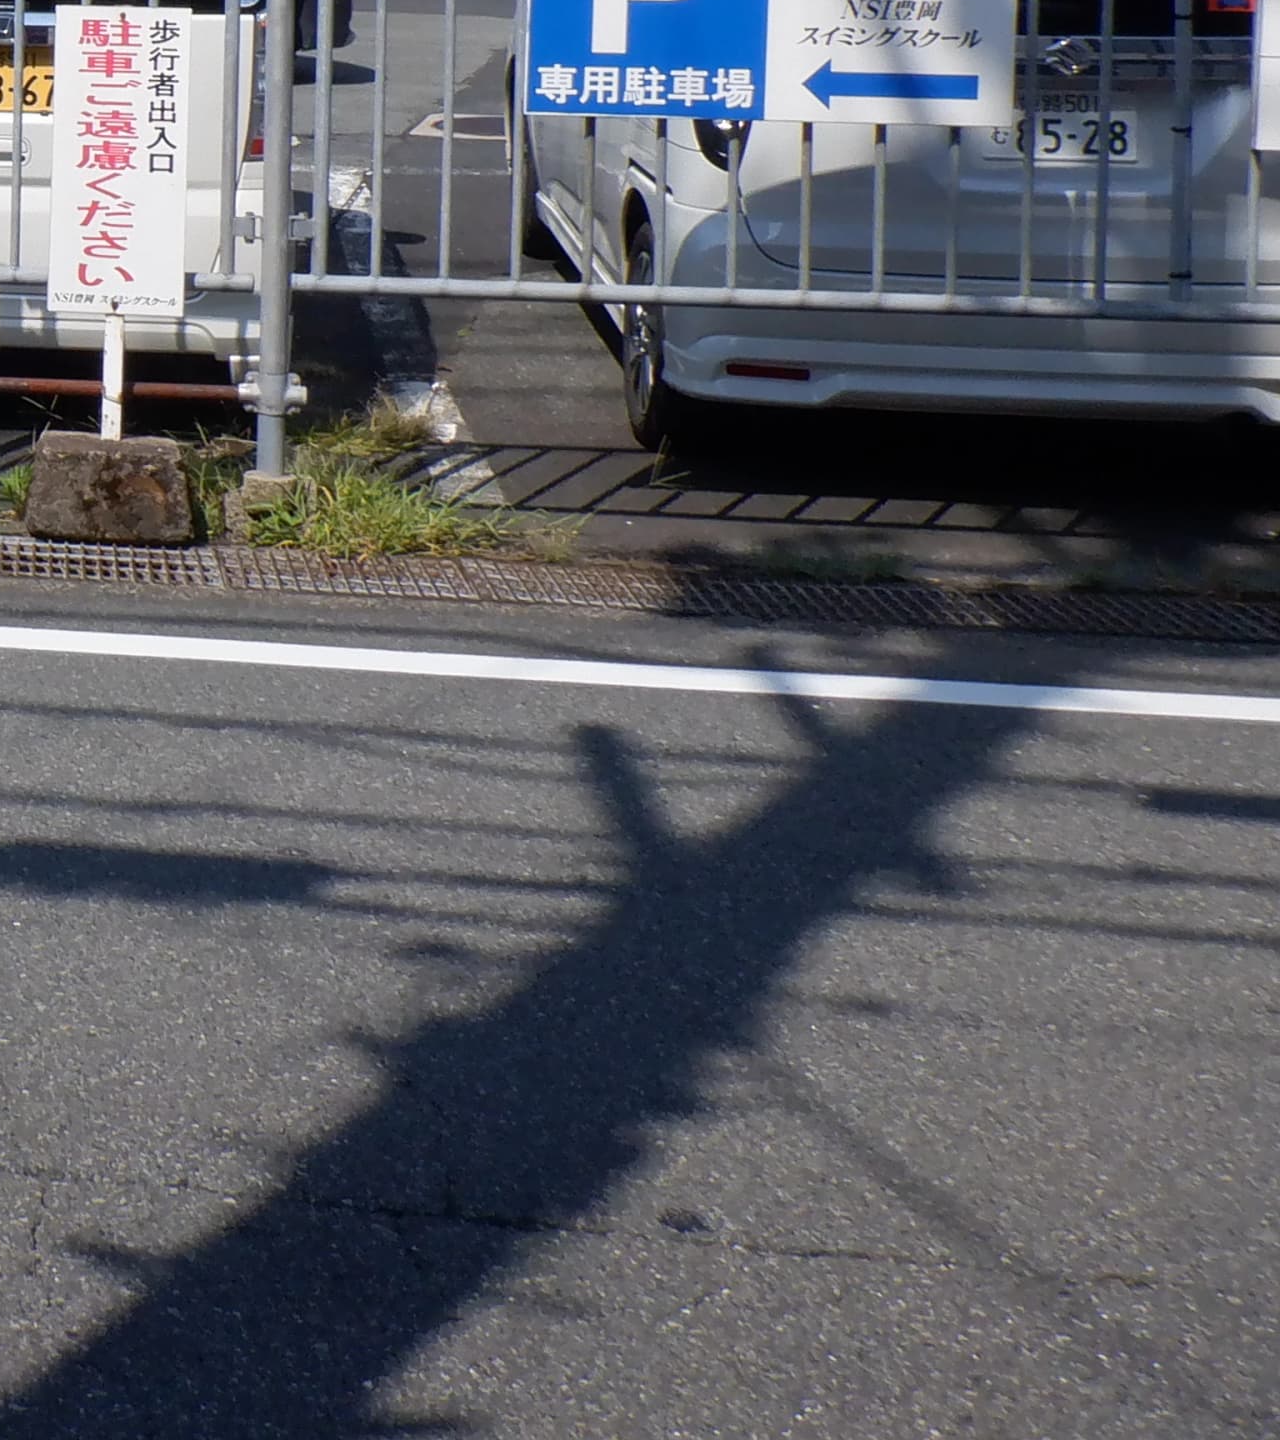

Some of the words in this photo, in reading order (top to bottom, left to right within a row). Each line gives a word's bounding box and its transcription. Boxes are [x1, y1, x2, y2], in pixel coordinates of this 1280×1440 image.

[840, 0, 942, 21] NSI豊岡
[797, 26, 983, 48] スイミングスクール
[146, 19, 180, 173] 歩行者出入口
[535, 64, 755, 108] 専用駐車場
[76, 19, 142, 286] 駐車ご遠慮ください
